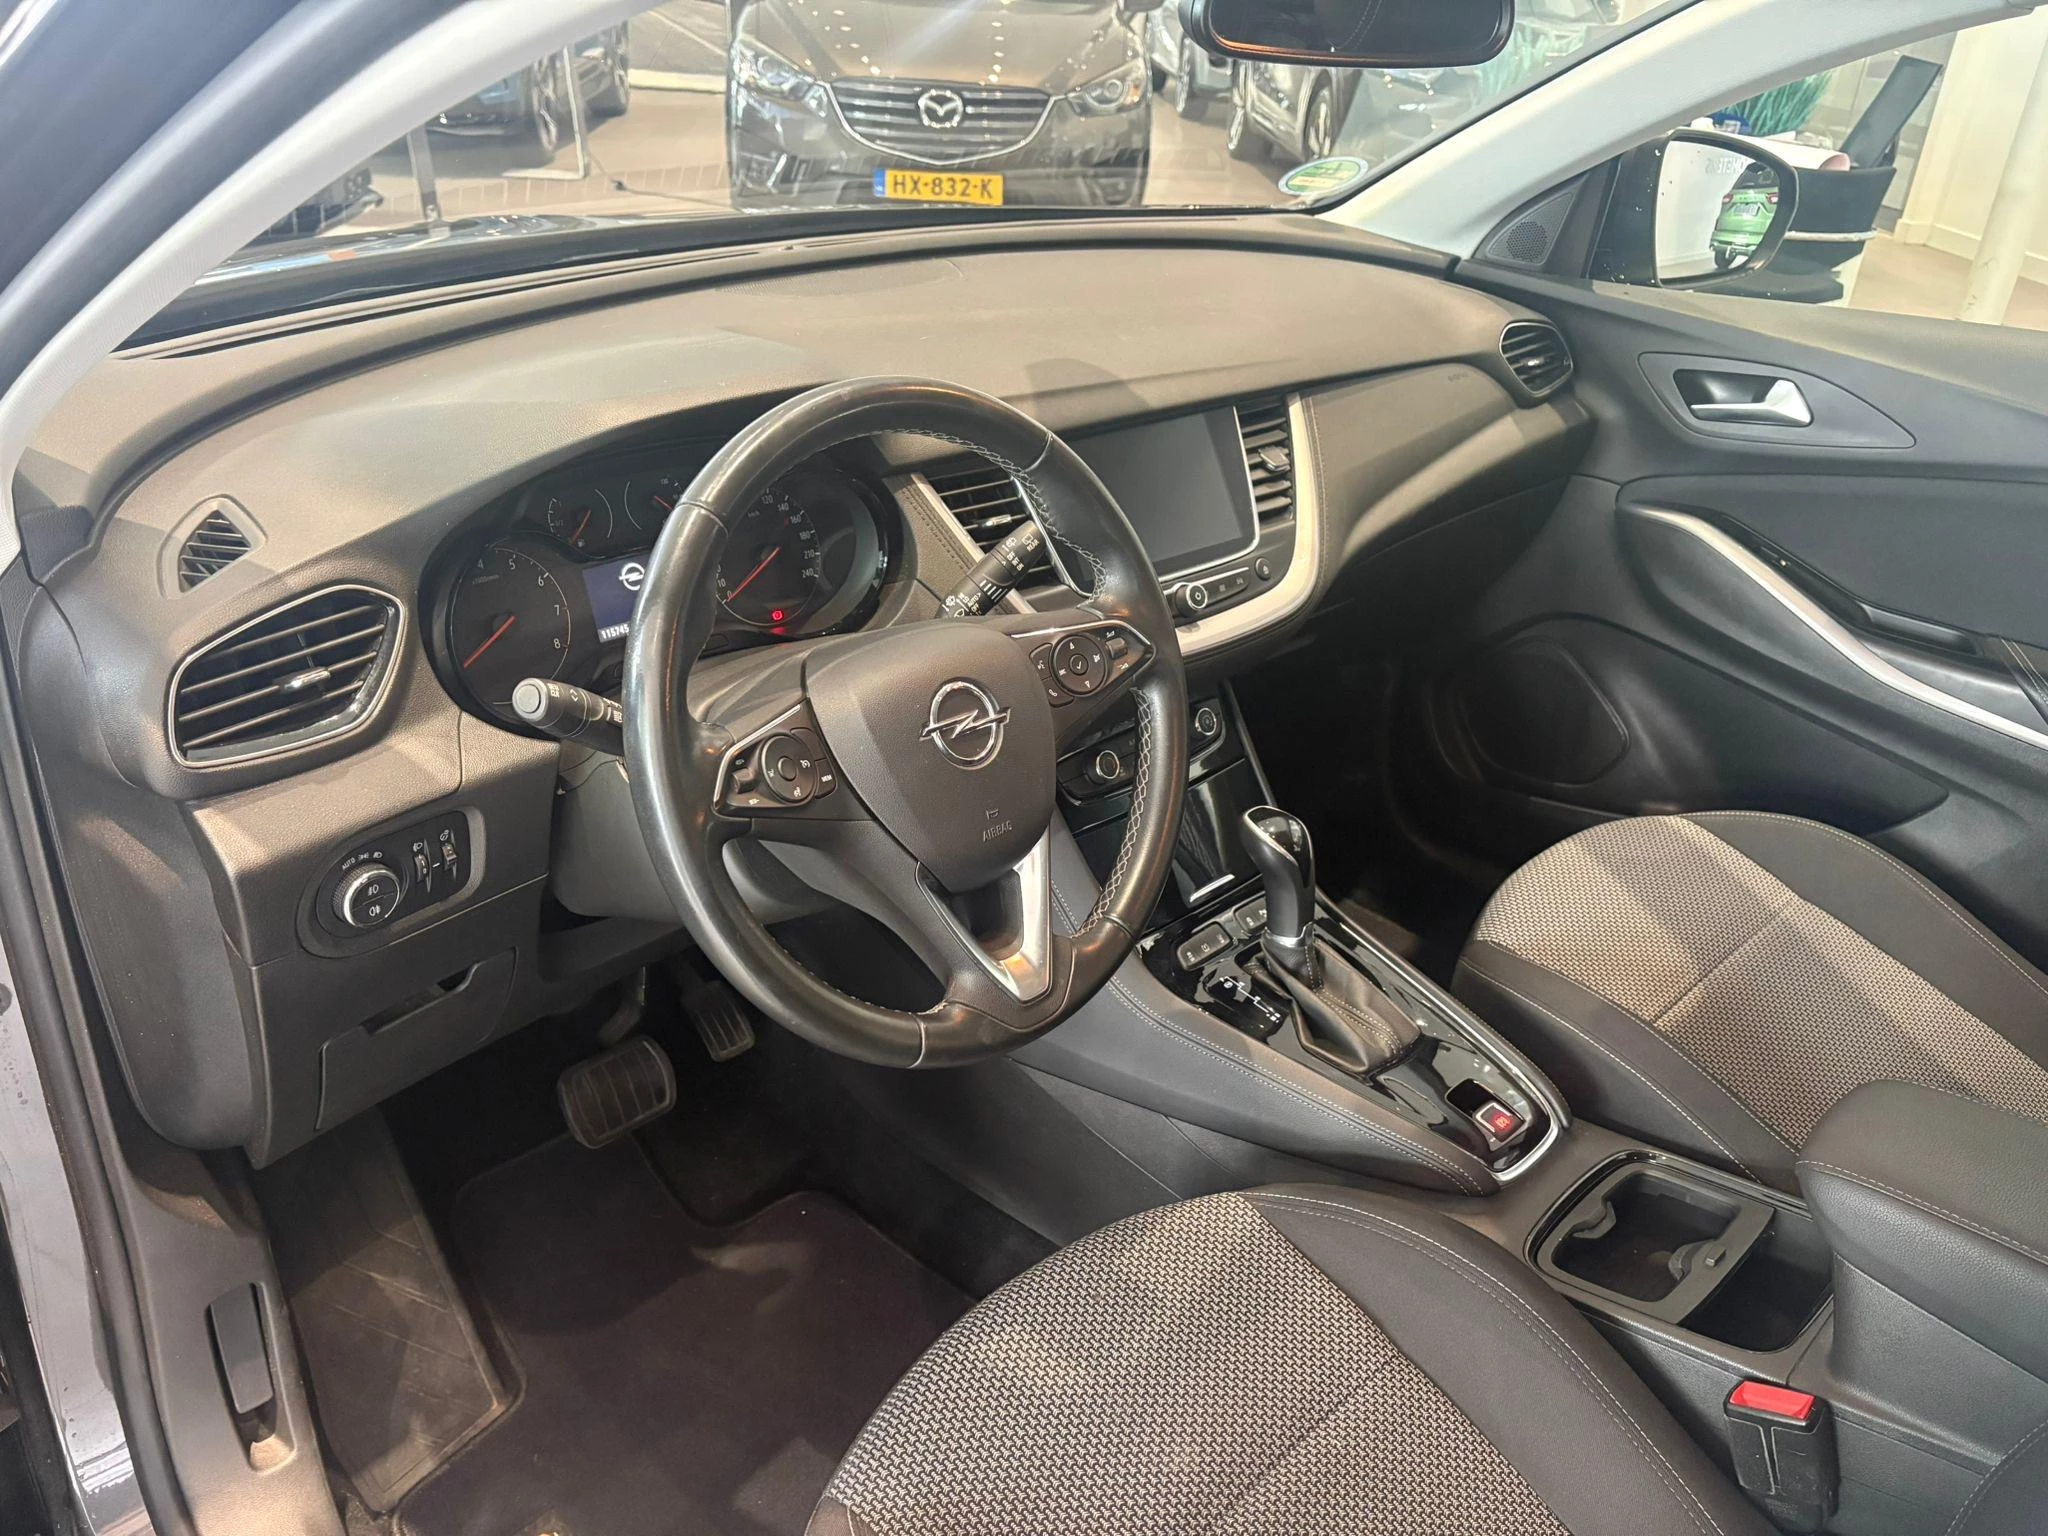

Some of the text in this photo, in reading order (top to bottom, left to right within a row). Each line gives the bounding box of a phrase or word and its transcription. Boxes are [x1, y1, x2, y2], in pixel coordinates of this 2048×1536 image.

[893, 175, 993, 199] HX-832-K
[478, 559, 484, 569] 4
[509, 559, 516, 570] 5
[802, 568, 814, 578] 240
[538, 576, 544, 587] 6
[718, 579, 726, 587] 10
[554, 605, 560, 616] 7
[601, 623, 630, 640] 115745
[553, 638, 561, 649] 8
[982, 820, 1012, 843] AIRBAG
[342, 856, 356, 871] AUTO
